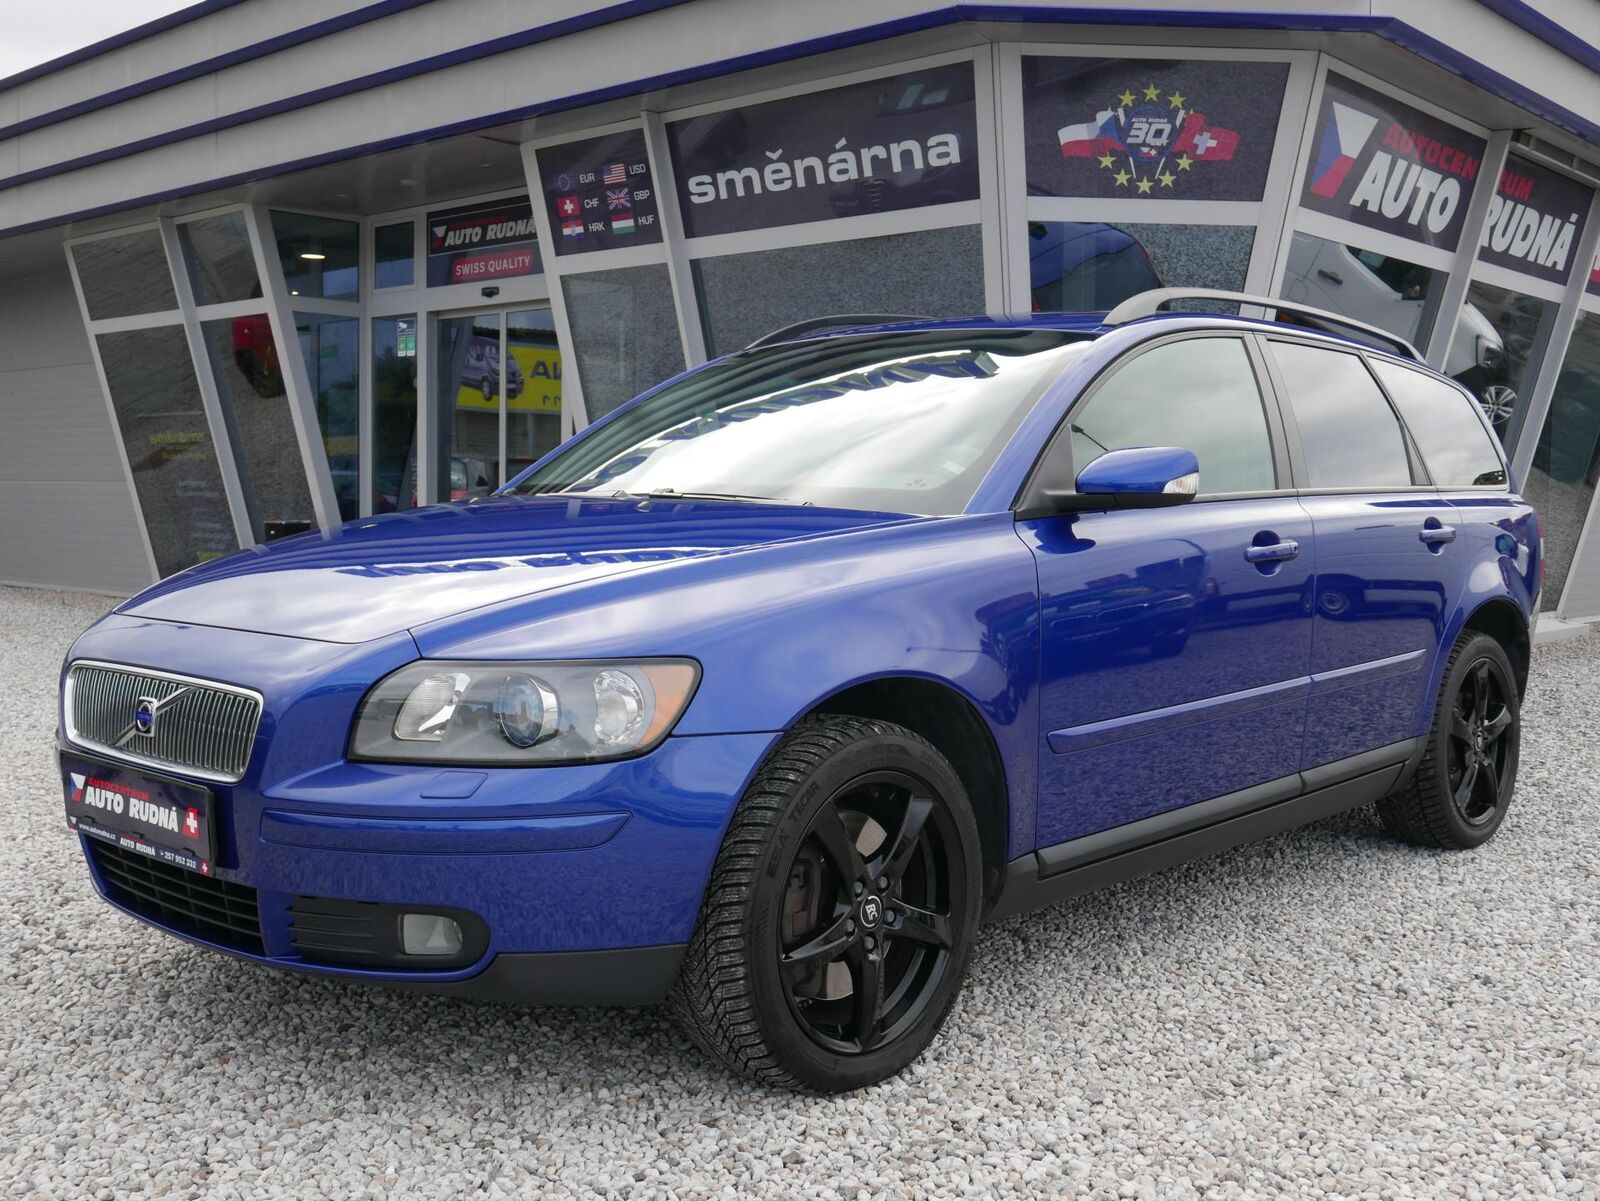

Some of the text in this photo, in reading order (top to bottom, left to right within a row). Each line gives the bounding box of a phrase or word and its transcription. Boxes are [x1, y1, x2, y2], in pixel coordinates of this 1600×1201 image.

[1126, 123, 1171, 145] 30
[629, 163, 646, 175] USD
[688, 132, 961, 204] směnárna
[580, 173, 595, 183] EUR
[633, 189, 650, 201] GBP
[1349, 150, 1461, 234] AUTO
[584, 198, 600, 209] CHF
[588, 222, 605, 232] HRK
[638, 215, 654, 226] HUF
[445, 226, 482, 246] AUTO
[1481, 195, 1579, 271] RUDNÁ
[456, 256, 530, 276] SWISS QUALITY
[85, 785, 179, 832] AUTO RUDNÁ
[120, 837, 135, 849] AUTO
